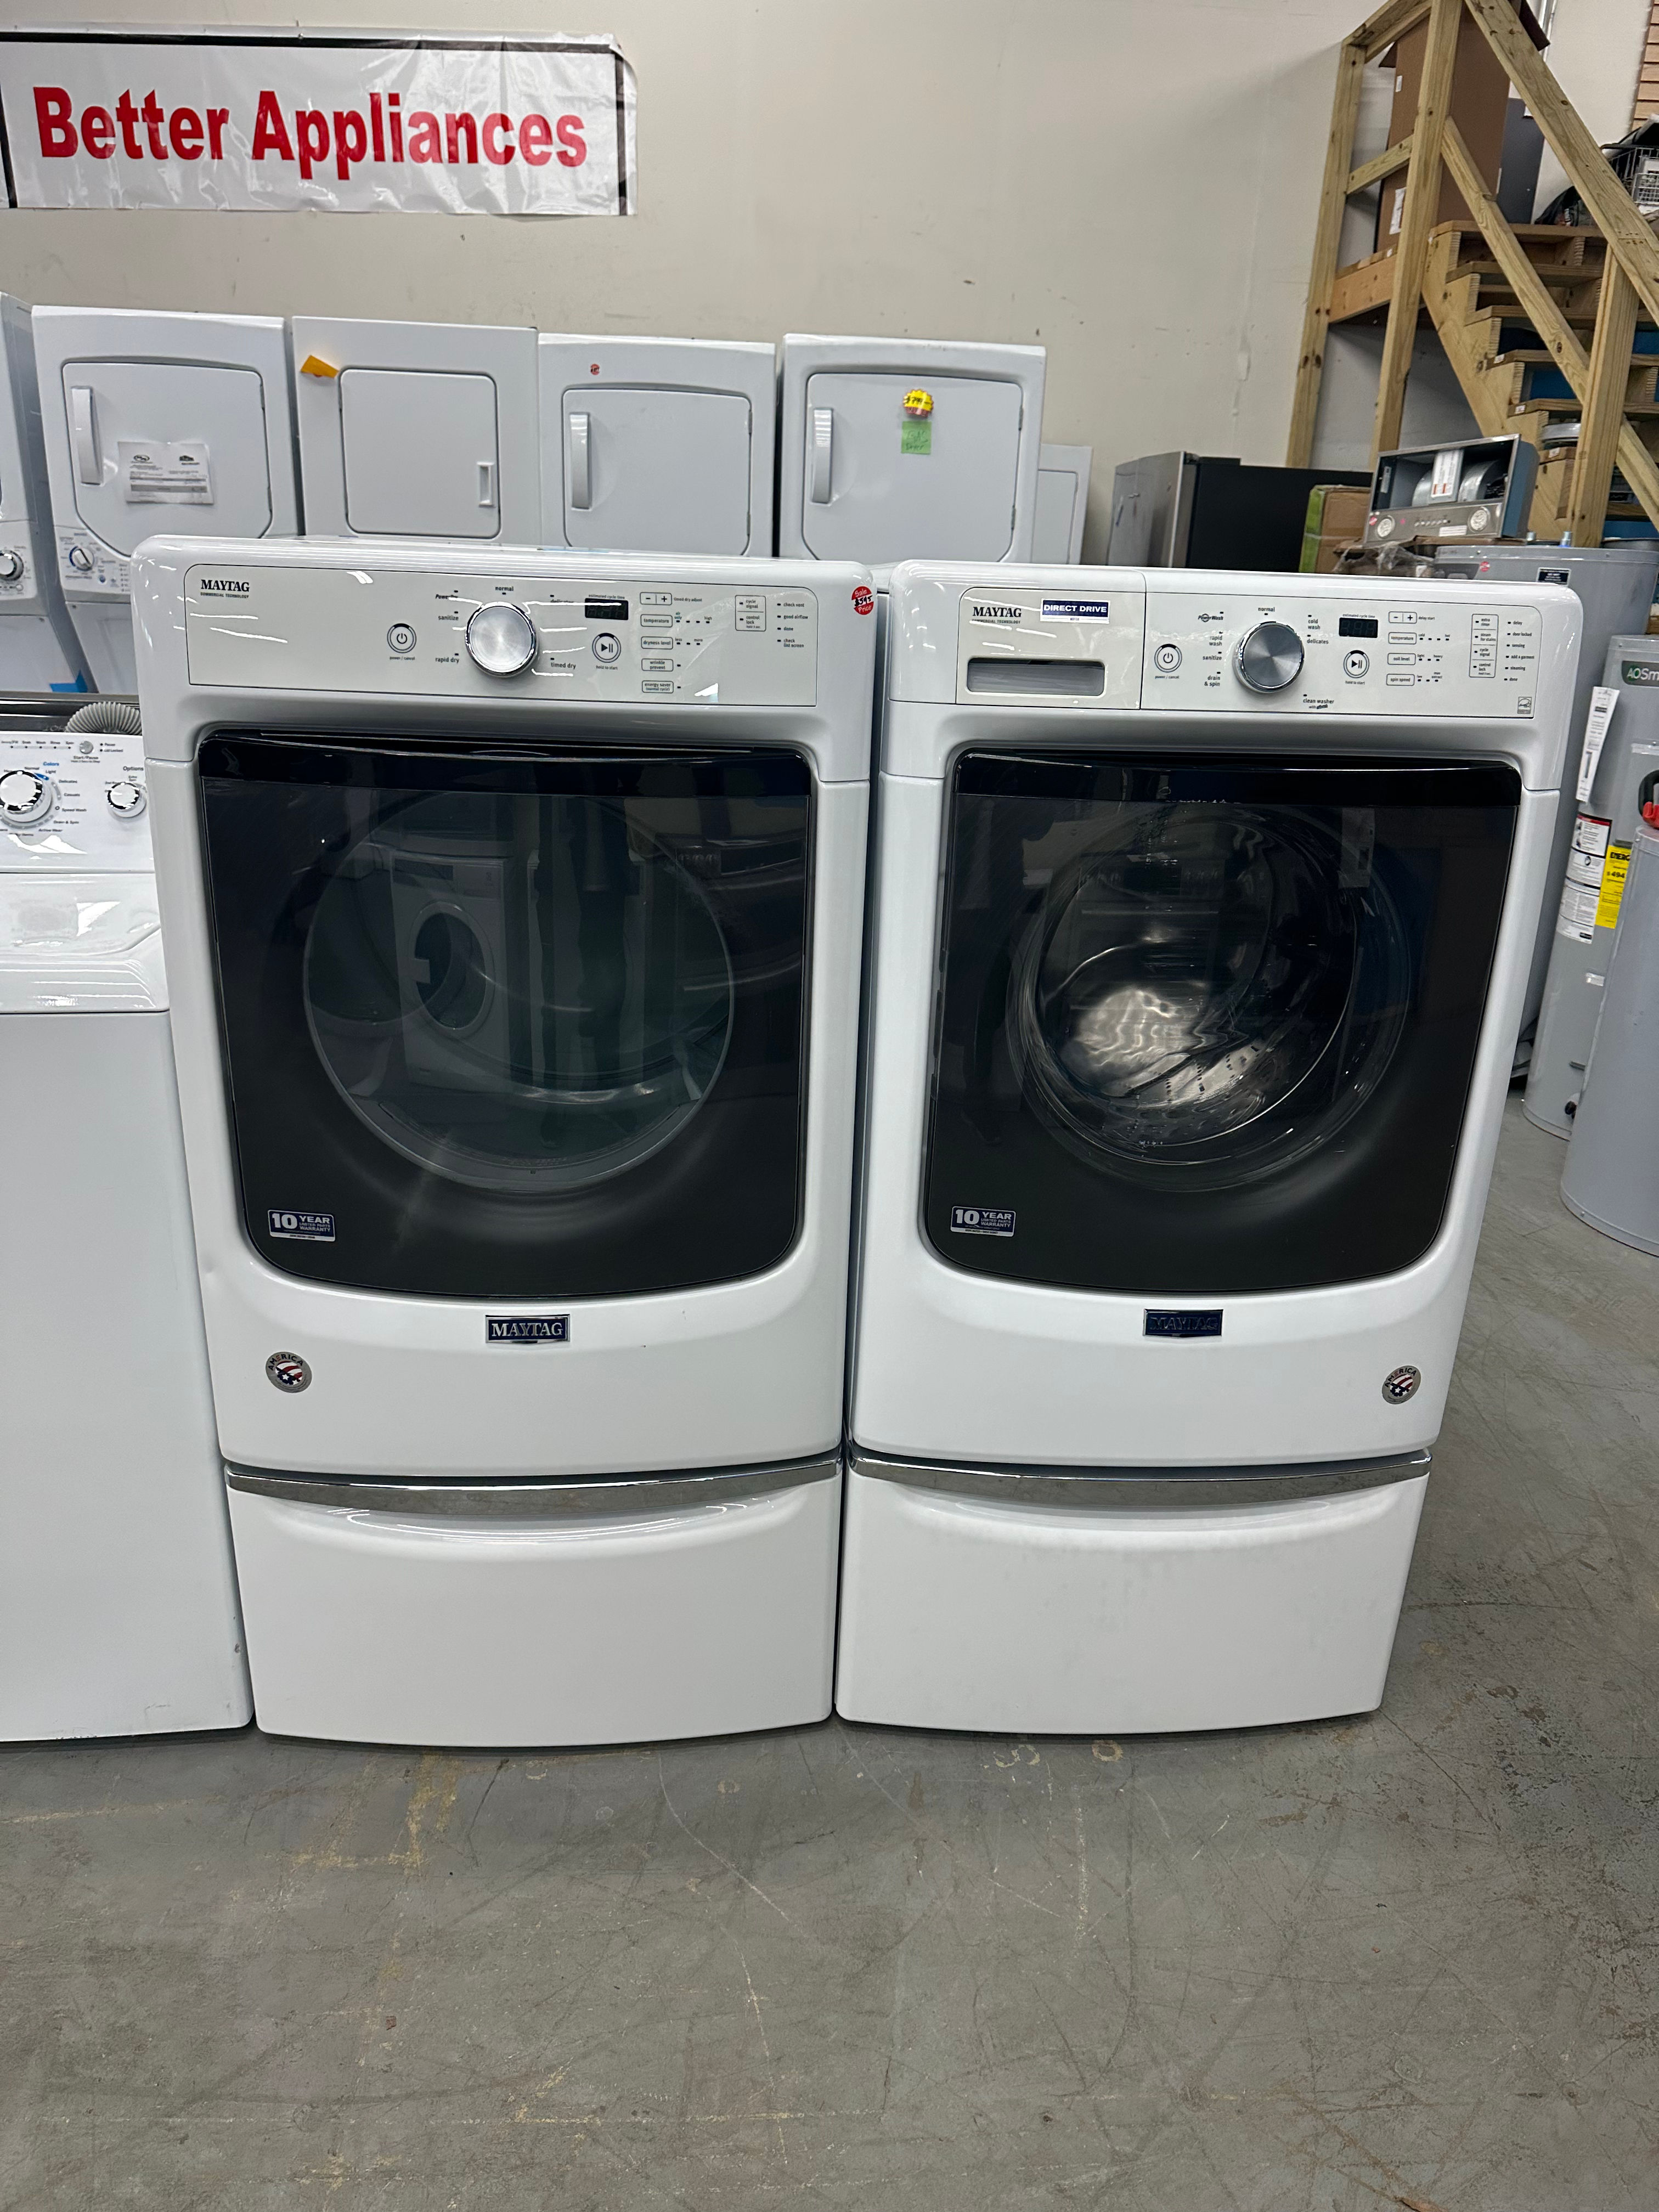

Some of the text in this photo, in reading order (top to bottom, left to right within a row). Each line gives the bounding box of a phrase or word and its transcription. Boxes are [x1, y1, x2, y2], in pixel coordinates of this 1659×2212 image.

[32, 86, 587, 180] Better Appliances
[201, 579, 250, 592] MAYTAG
[855, 588, 867, 597] Sale
[858, 605, 872, 613] Price
[972, 606, 1022, 617] MAYTAG
[272, 1213, 330, 1229] 10 YEAR
[956, 1209, 1012, 1224] 10 YEAR
[492, 1322, 563, 1336] MAYTAG
[1150, 1317, 1218, 1330] MAYTAG
[268, 1353, 303, 1371] AMERICA
[1384, 1367, 1417, 1388] AMERICA
